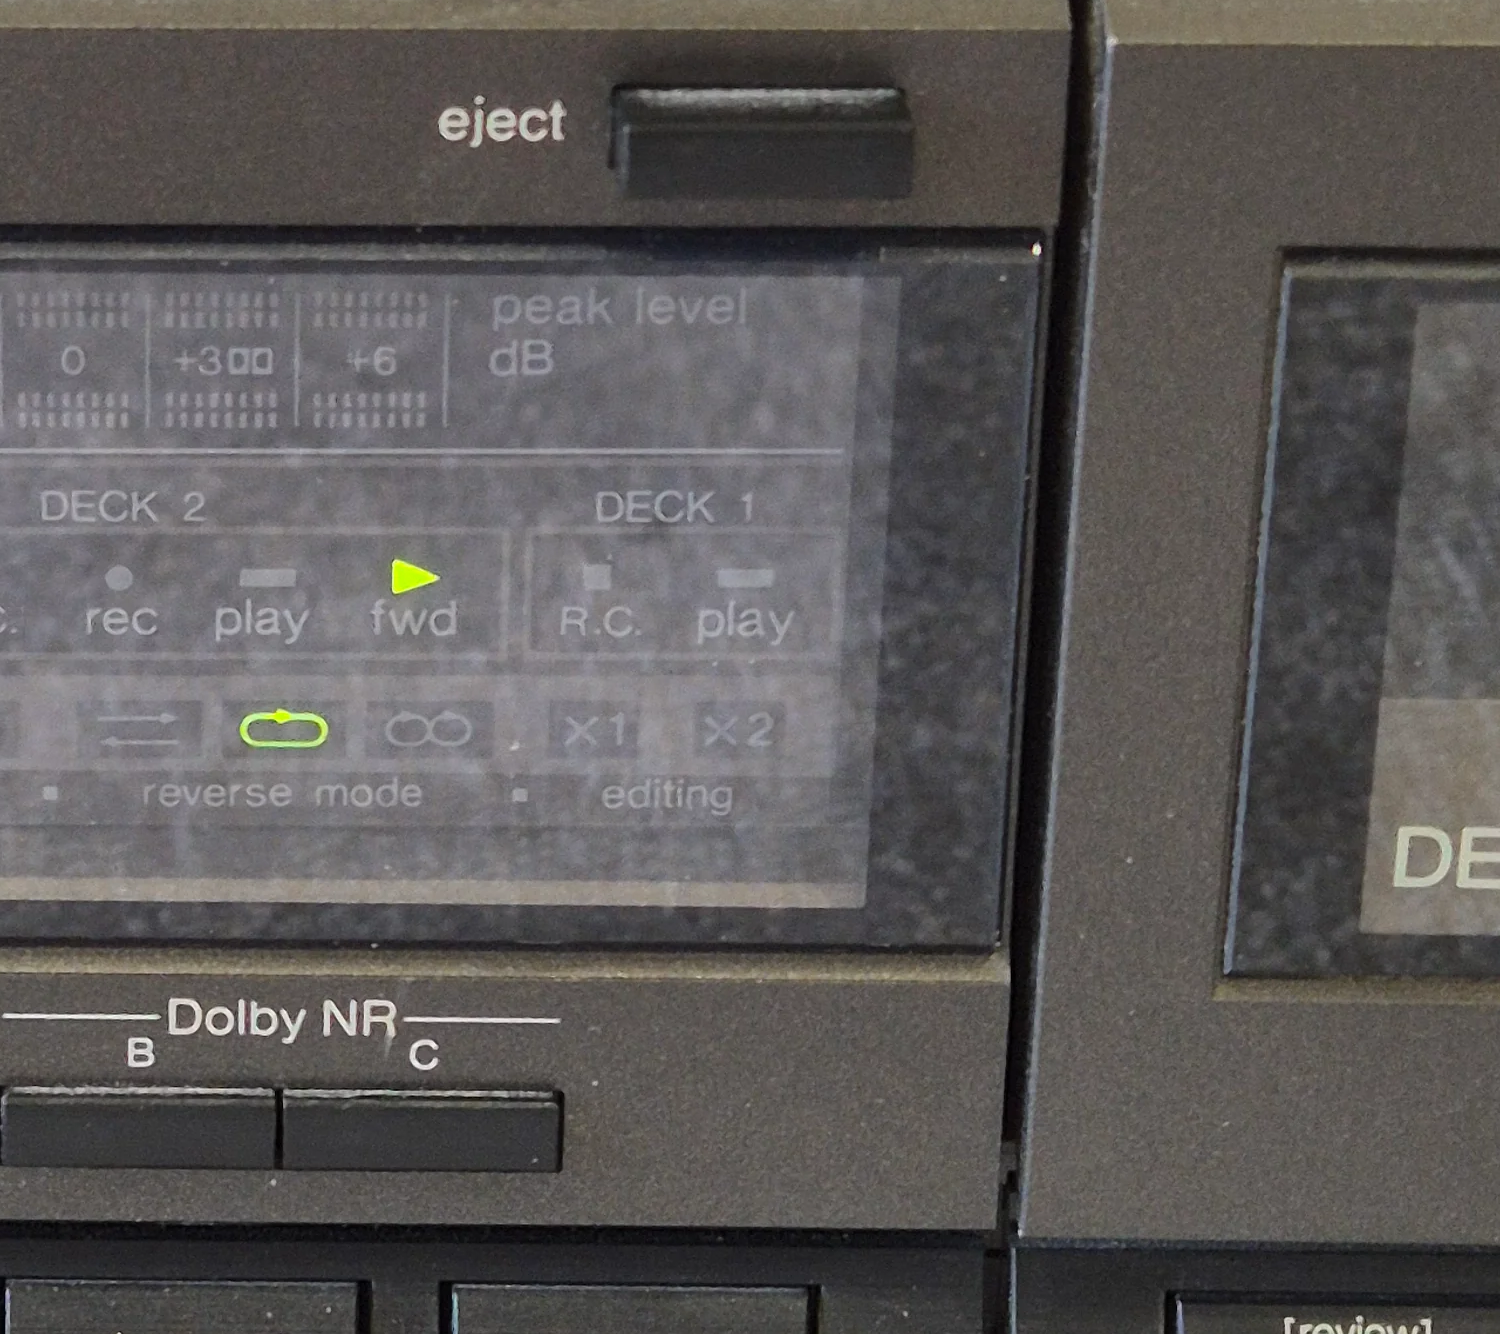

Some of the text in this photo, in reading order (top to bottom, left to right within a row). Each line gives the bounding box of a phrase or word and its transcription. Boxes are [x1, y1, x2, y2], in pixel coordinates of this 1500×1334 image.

[438, 95, 568, 148] eject
[492, 287, 748, 332] peak level
[60, 347, 85, 375] 0
[348, 345, 397, 376] +6
[489, 341, 554, 376] dB
[40, 491, 206, 522] DECK 2
[596, 493, 755, 523] DECK 1
[85, 607, 158, 636] rec
[214, 603, 310, 645] play
[371, 601, 459, 636] fwd
[560, 605, 643, 638] R.C.
[698, 605, 796, 646] play
[143, 778, 422, 808] reverse mode
[603, 780, 733, 815] editing
[168, 998, 397, 1044] Dolby NR
[128, 1038, 155, 1067] B
[410, 1039, 439, 1070] C
